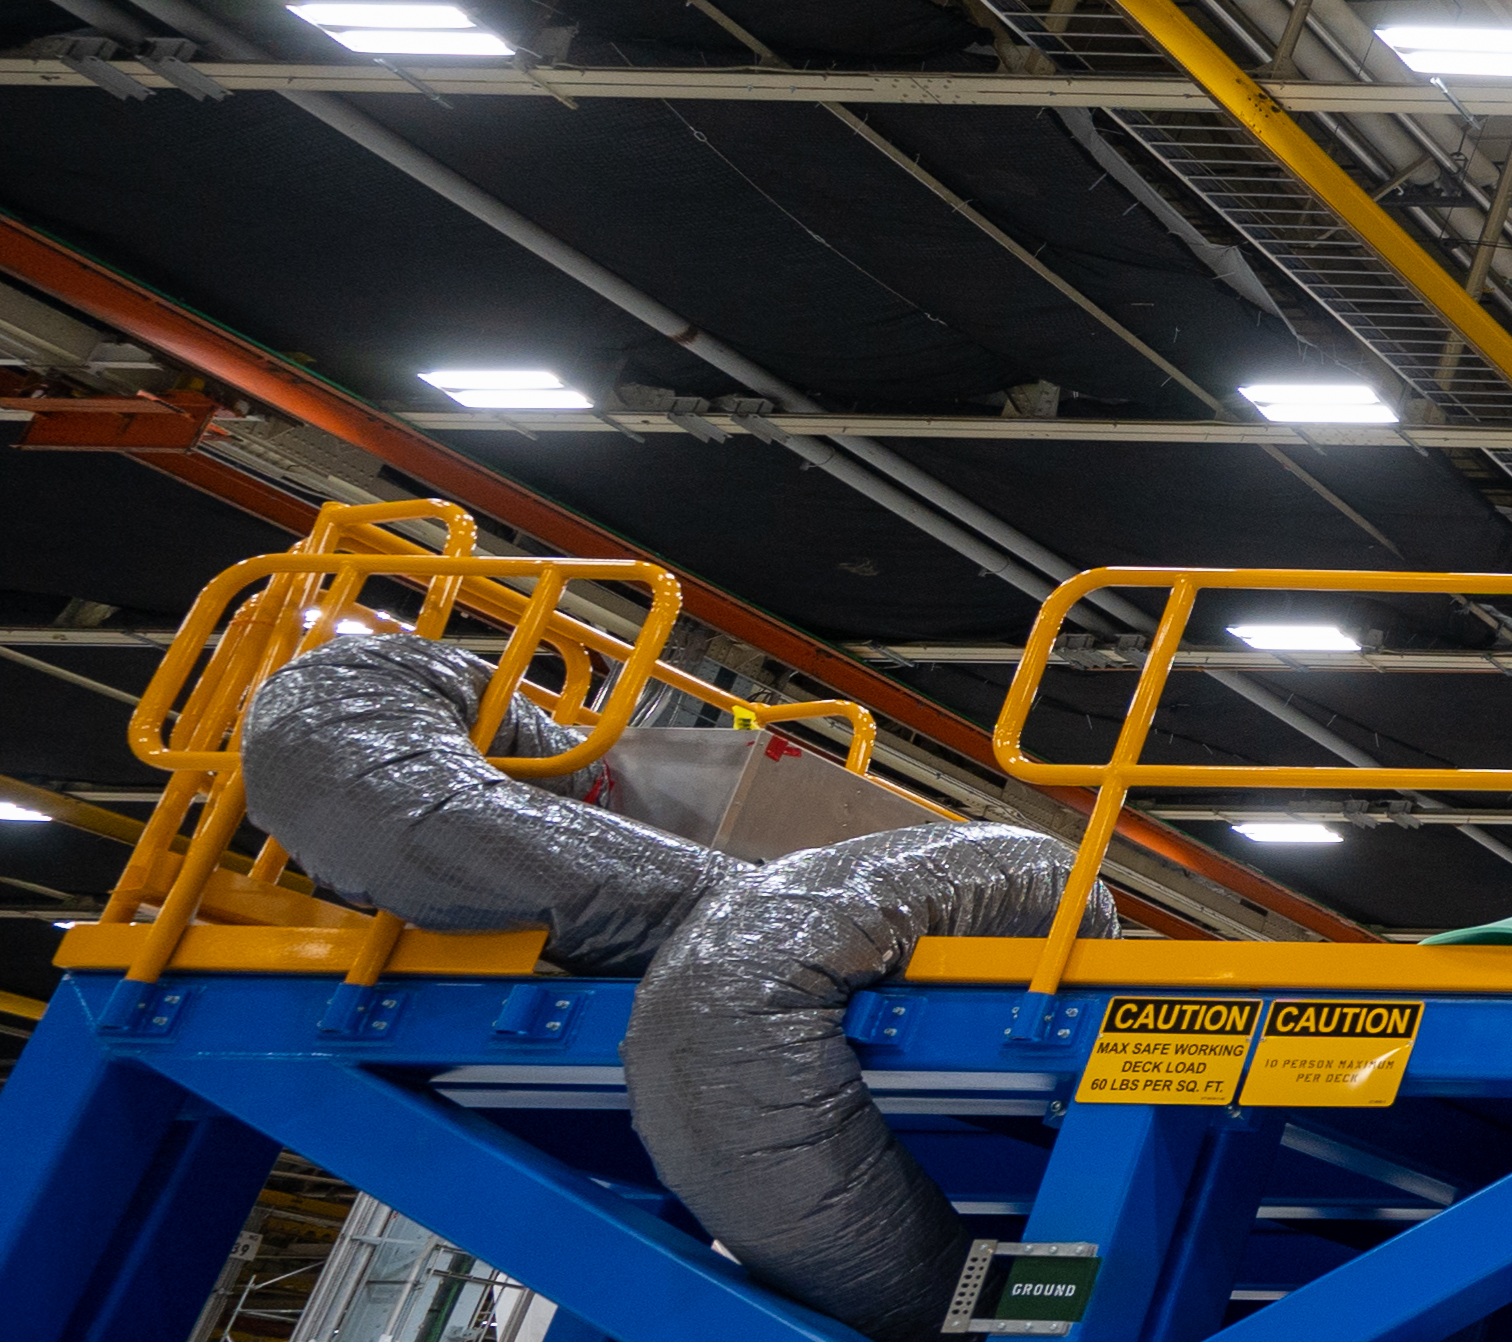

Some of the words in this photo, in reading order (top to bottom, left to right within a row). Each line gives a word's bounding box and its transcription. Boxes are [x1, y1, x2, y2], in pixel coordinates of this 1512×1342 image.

[1114, 1003, 1250, 1032] CAUTION
[1276, 1007, 1411, 1034] CAUTION
[1097, 1043, 1128, 1055] MAX
[1132, 1043, 1170, 1056] SAFE
[1174, 1044, 1244, 1057] WORKING
[1121, 1061, 1162, 1074] DECK
[1166, 1062, 1206, 1074] LOAD
[1281, 1059, 1334, 1069] PERSON
[1337, 1060, 1394, 1070] MAXIMUM
[1295, 1073, 1321, 1083] PER
[1325, 1074, 1358, 1084] DECK
[1091, 1078, 1107, 1091] 60
[1110, 1079, 1138, 1091] LBS
[1142, 1079, 1172, 1092] PER
[1175, 1080, 1200, 1094] SQ.
[1203, 1081, 1224, 1093] FT.
[1012, 1283, 1076, 1297] GROUND
